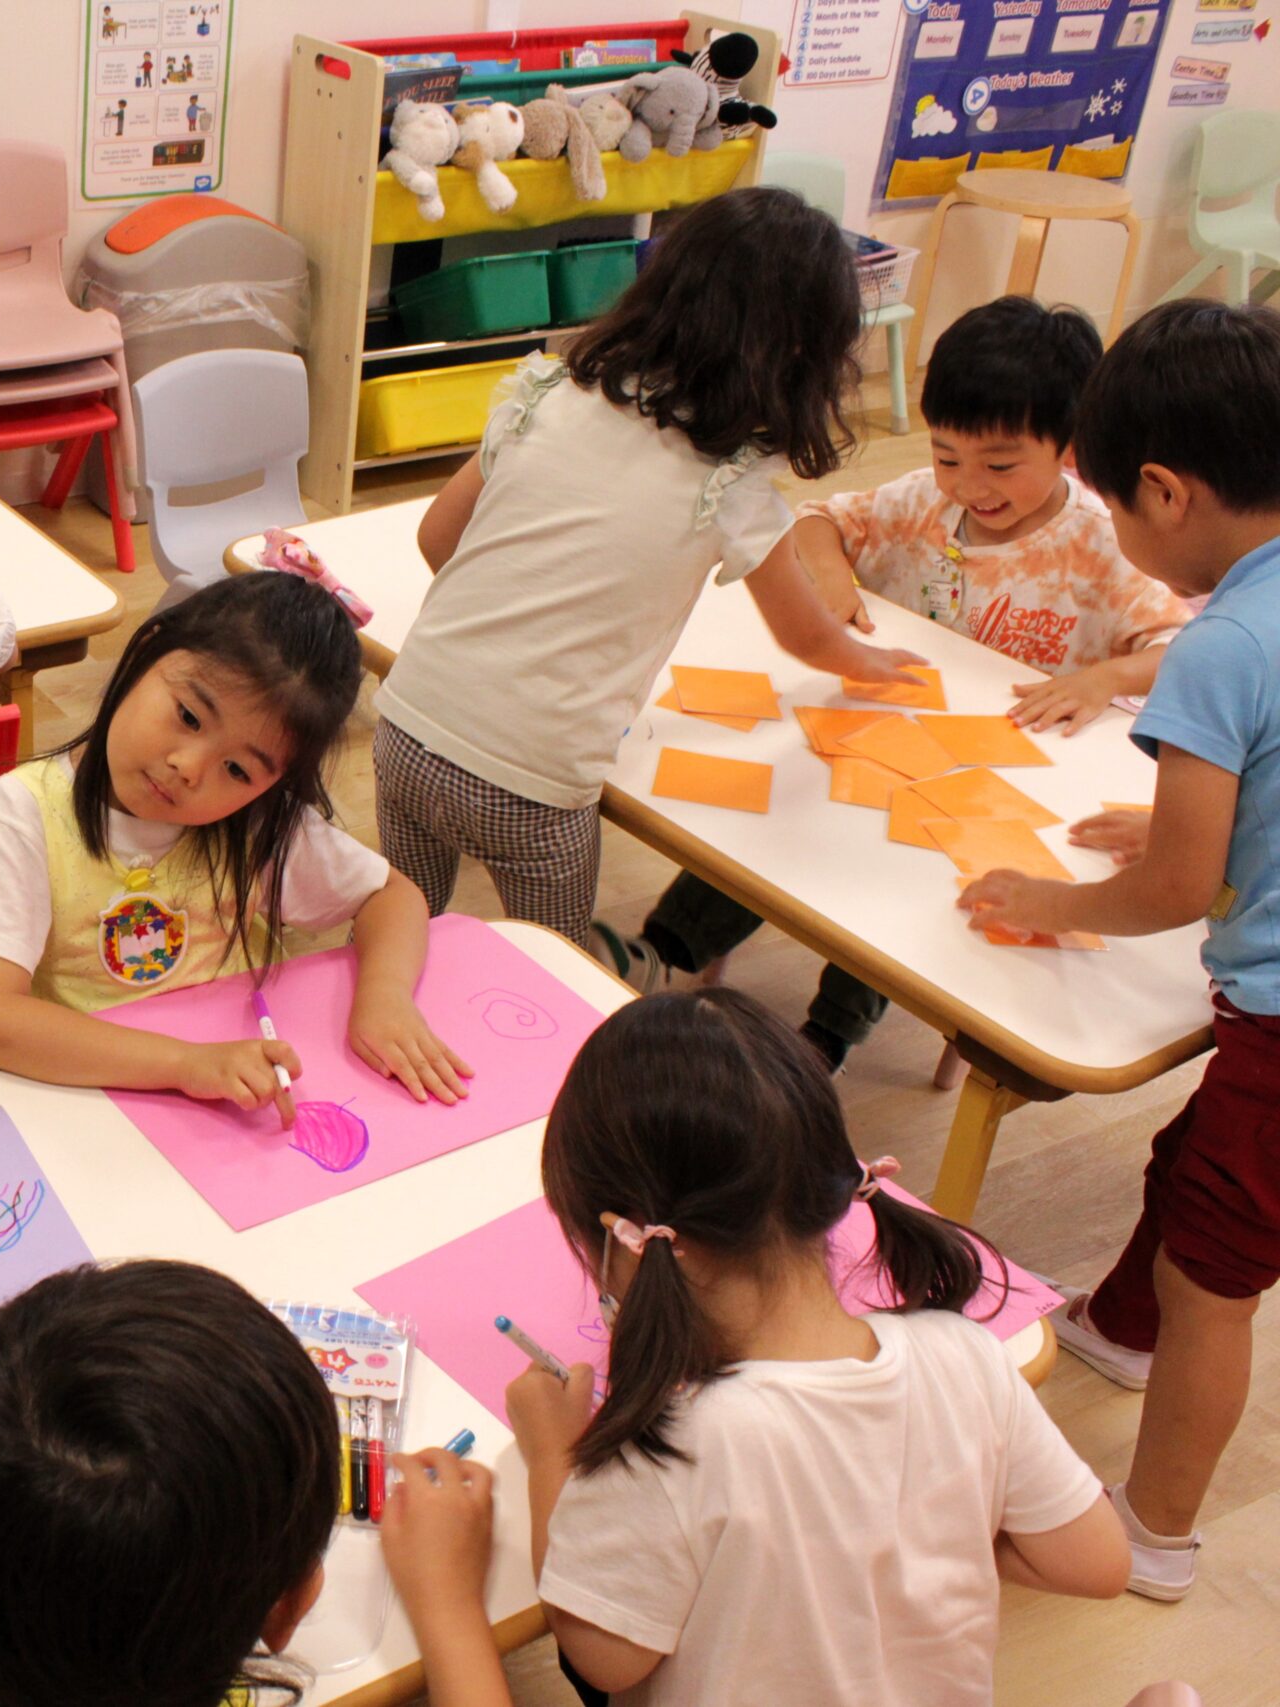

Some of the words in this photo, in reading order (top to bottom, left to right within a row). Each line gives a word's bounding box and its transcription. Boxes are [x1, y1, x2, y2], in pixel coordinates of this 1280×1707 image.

[928, 2, 960, 20] Today
[994, 0, 1042, 17] Yesterday
[802, 12, 810, 23] 2
[816, 12, 839, 20] Month
[800, 28, 808, 37] 3
[814, 27, 840, 36] Today's
[1000, 33, 1022, 43] Sunday
[1064, 29, 1093, 39] Tuesday
[927, 35, 953, 44] Monday
[799, 42, 806, 51] 4
[796, 57, 804, 67] 5
[809, 58, 828, 66] Daily
[830, 55, 862, 64] Schedule
[807, 72, 818, 80] 100
[819, 71, 837, 79] Days
[848, 68, 872, 77] School
[1174, 62, 1197, 74] Center
[1200, 66, 1215, 76] Time
[990, 72, 1028, 91] Today's
[1028, 69, 1075, 88] Weather
[1009, 608, 1078, 641] SURF
